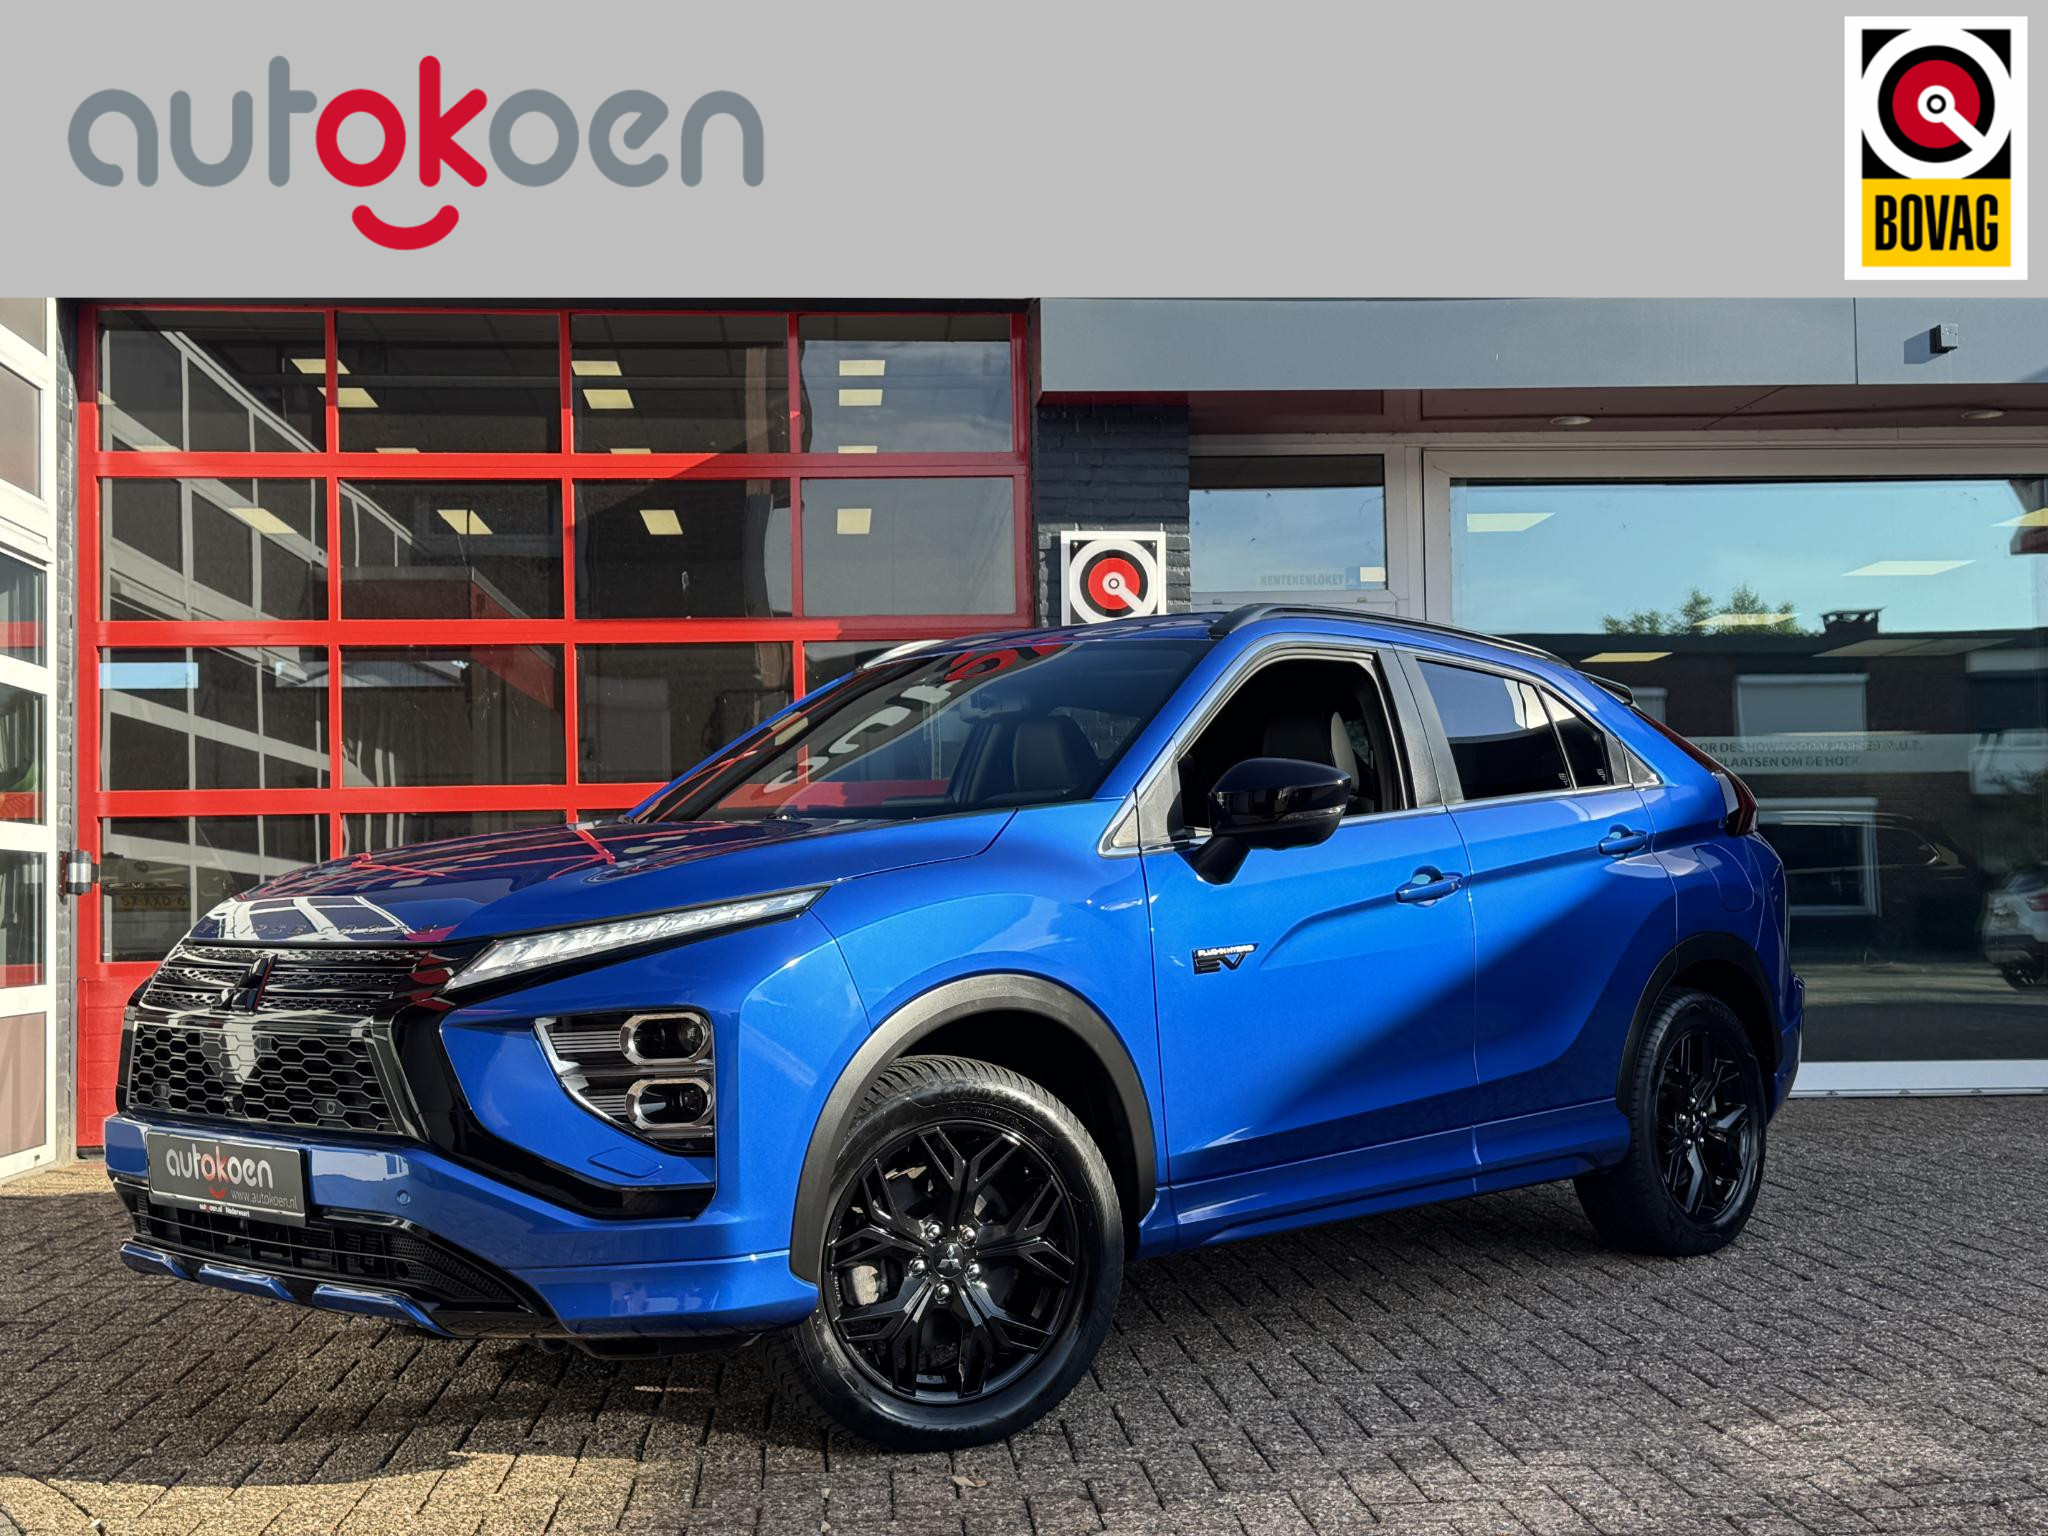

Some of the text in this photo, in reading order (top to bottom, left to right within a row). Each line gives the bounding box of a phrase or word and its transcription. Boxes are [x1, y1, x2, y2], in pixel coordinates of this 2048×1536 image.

[1720, 742, 1737, 753] DE
[1782, 756, 1803, 767] OM
[1193, 952, 1248, 975] EV
[166, 1142, 274, 1190] autokoen
[231, 1189, 298, 1210] www.autokoen.nl
